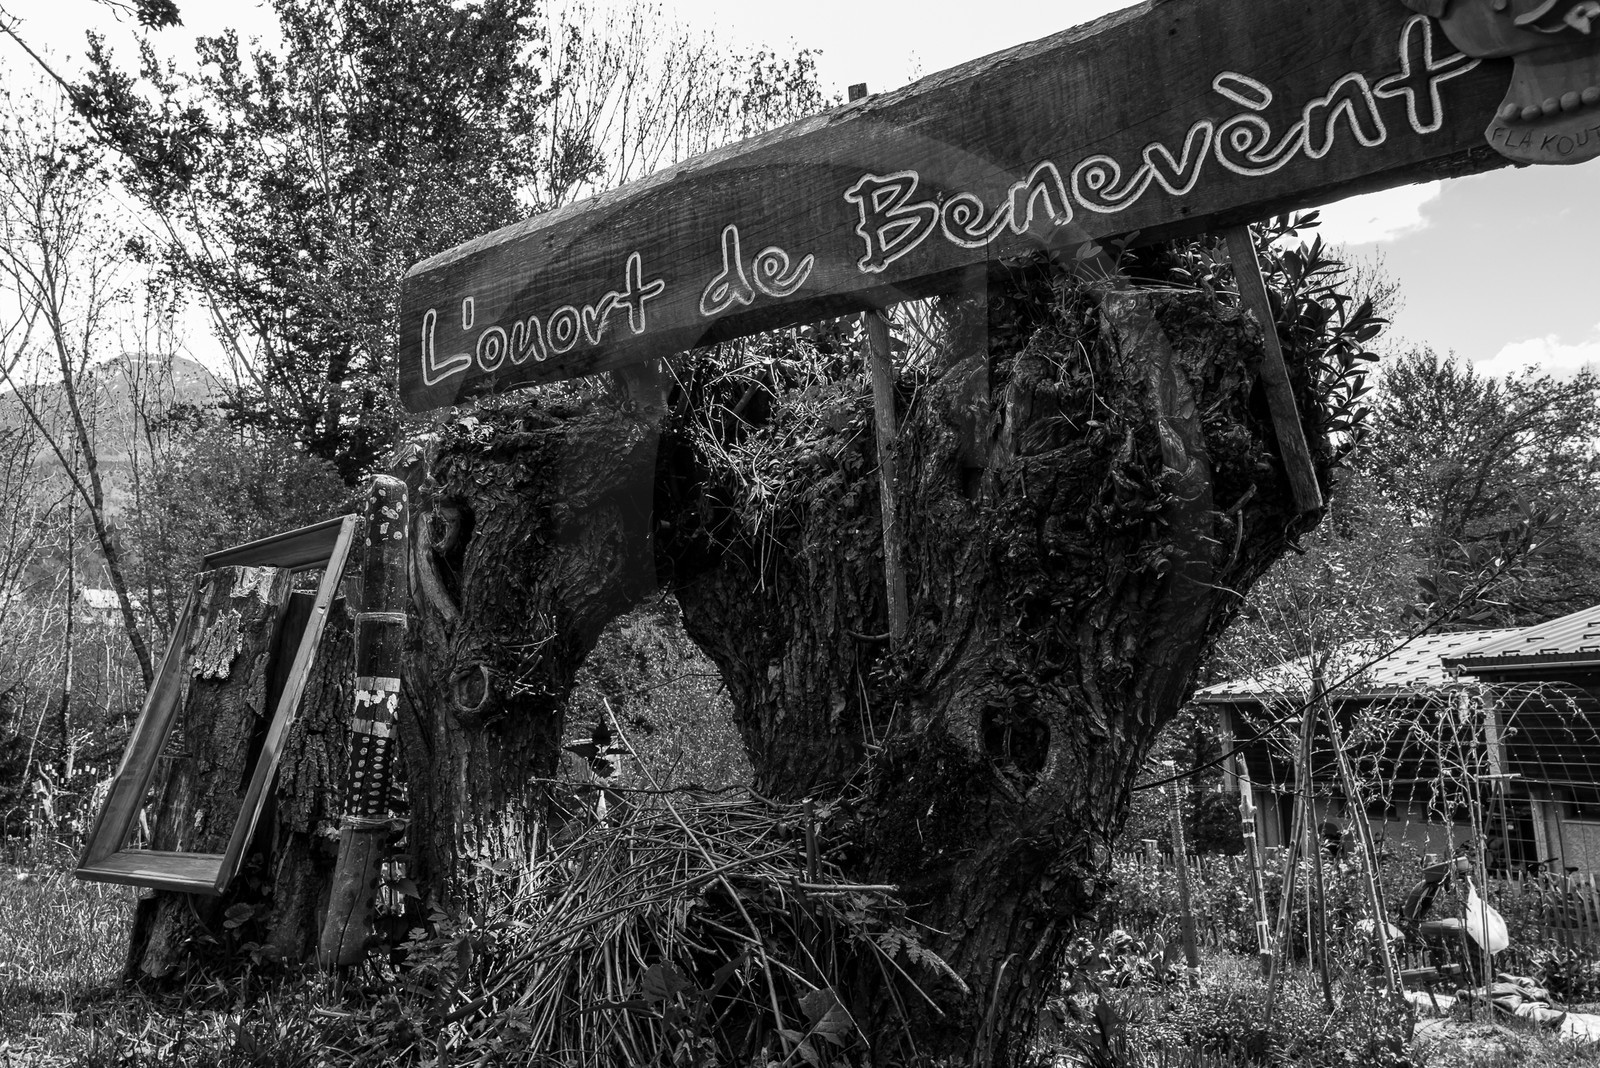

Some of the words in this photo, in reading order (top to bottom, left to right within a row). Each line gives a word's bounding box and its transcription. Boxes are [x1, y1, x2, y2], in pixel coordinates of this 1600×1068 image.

[420, 251, 665, 386] L'ouort
[699, 224, 815, 317] de
[844, 14, 1482, 275] Benevènt
